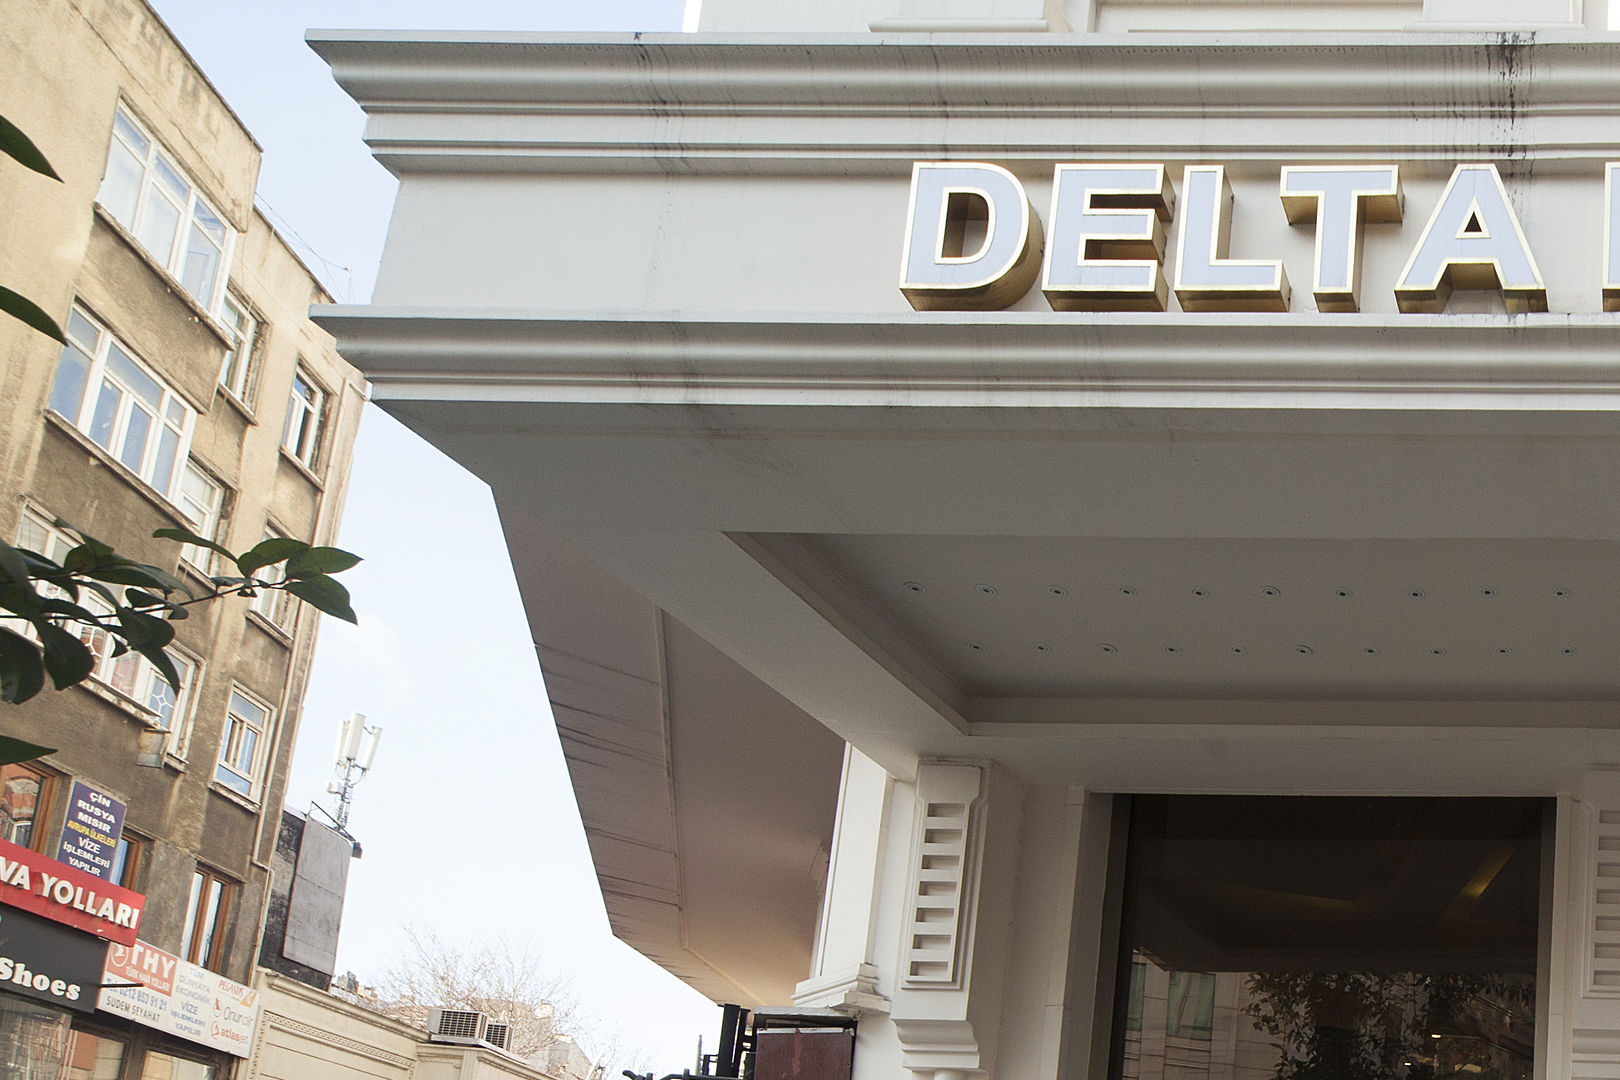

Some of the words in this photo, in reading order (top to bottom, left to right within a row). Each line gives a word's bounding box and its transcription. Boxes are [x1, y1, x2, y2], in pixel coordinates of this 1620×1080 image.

[900, 161, 1548, 306] DELTA
[77, 799, 115, 823] RUSYA
[78, 811, 111, 833] MISIR
[78, 836, 102, 854] VİZE
[68, 856, 101, 876] YAPILIR
[0, 856, 30, 890] VA
[42, 872, 139, 929] YOLLARI
[131, 943, 176, 979] THY
[0, 957, 81, 1001] Shoes
